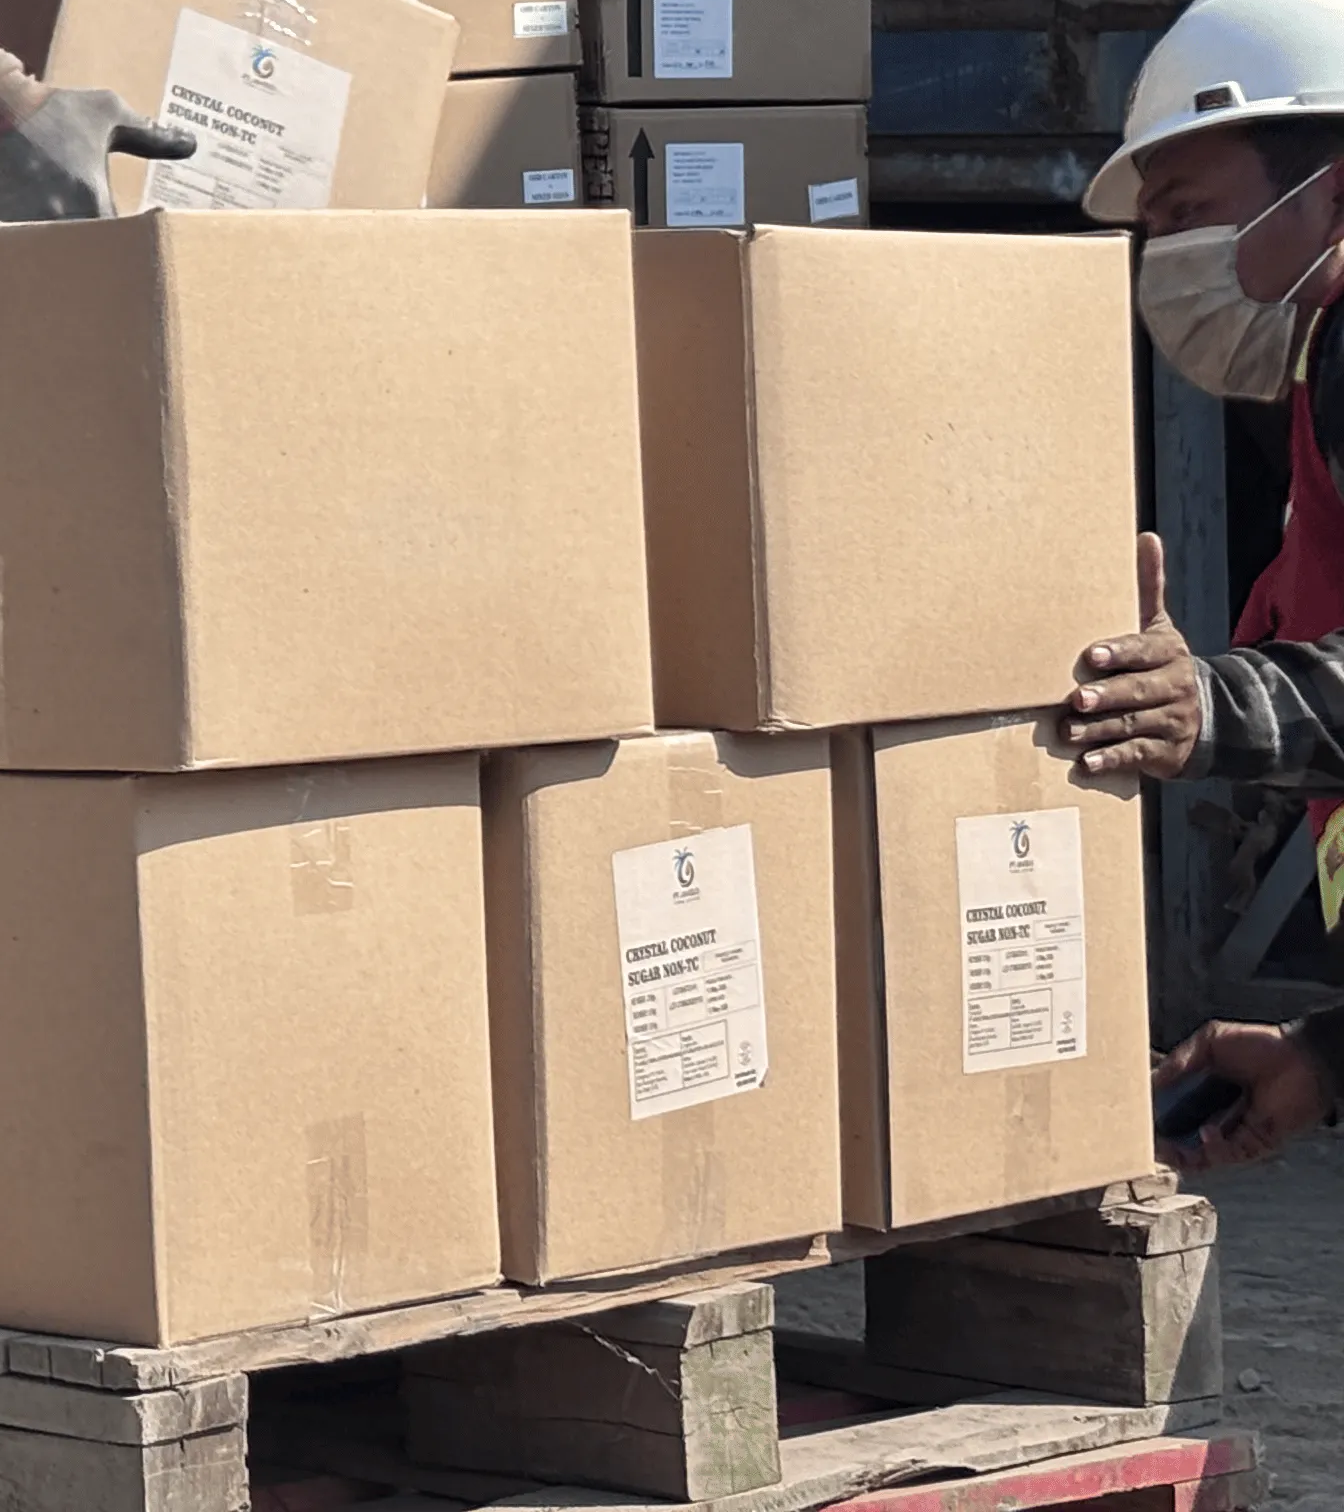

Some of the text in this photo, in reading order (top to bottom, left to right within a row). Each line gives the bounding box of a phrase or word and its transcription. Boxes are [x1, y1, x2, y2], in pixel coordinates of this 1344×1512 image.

[167, 101, 257, 145] SUGAR NON-TC
[171, 84, 286, 137] CRYSTAL COCONUT
[966, 900, 1047, 923] CRYSTAL COCONUT
[625, 928, 717, 964] CRYSTAL COCONUT
[966, 927, 997, 946] SUGAR
[627, 956, 700, 987] SUGAR NON-TC
